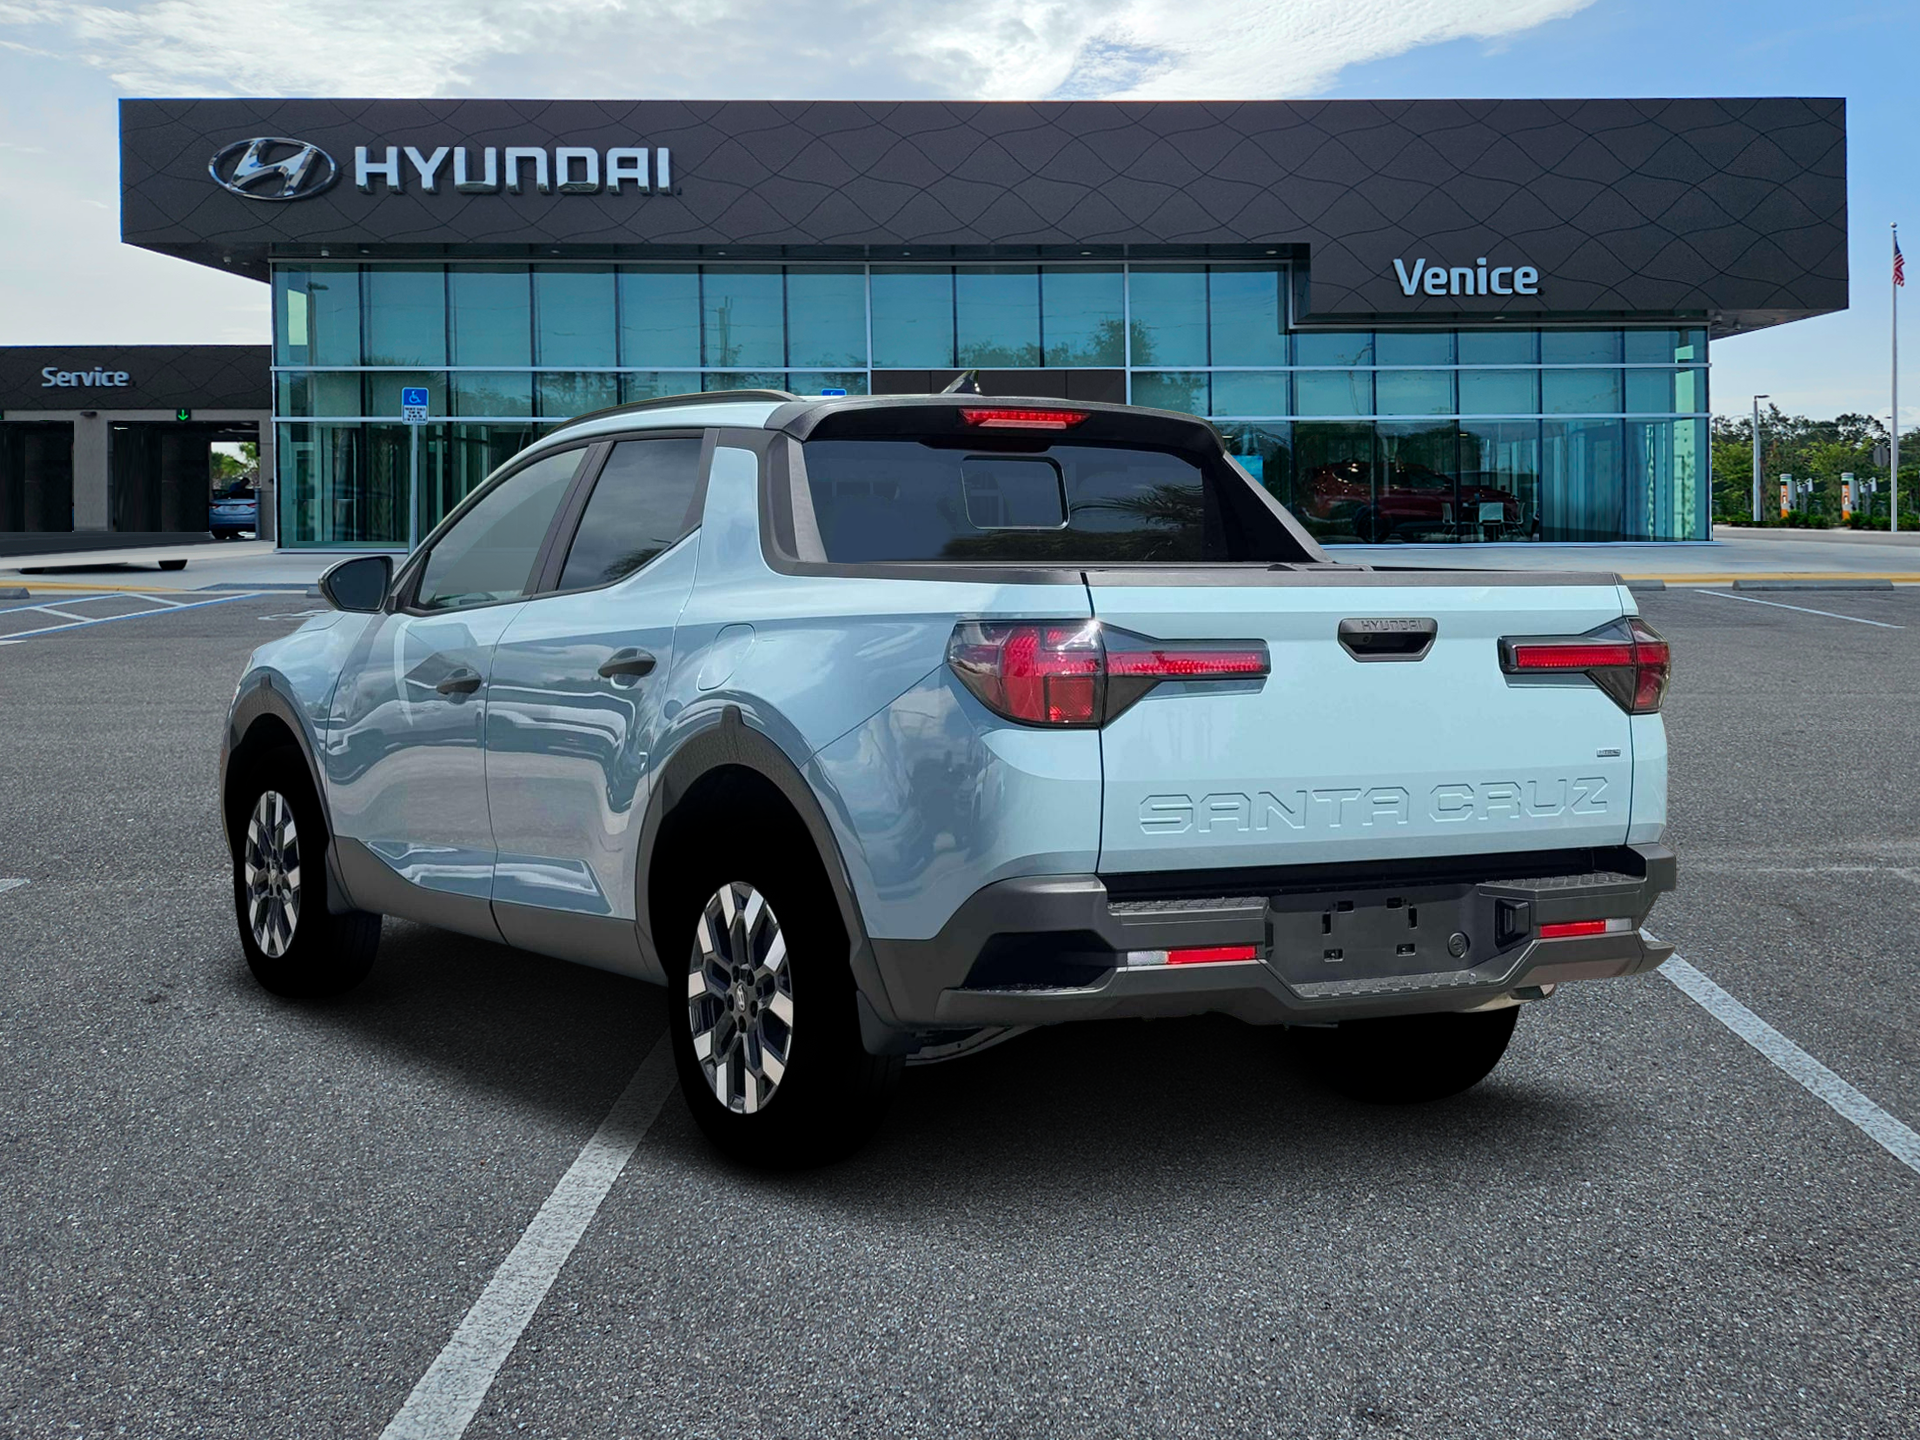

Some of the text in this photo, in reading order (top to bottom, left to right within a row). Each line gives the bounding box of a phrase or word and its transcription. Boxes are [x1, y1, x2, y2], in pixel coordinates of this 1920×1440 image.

[354, 145, 672, 193] HYUNDAI
[1393, 257, 1539, 296] Venice
[41, 367, 130, 387] Service
[1361, 620, 1424, 631] HYUNDAI
[1139, 777, 1608, 834] SANTA CRUZ
